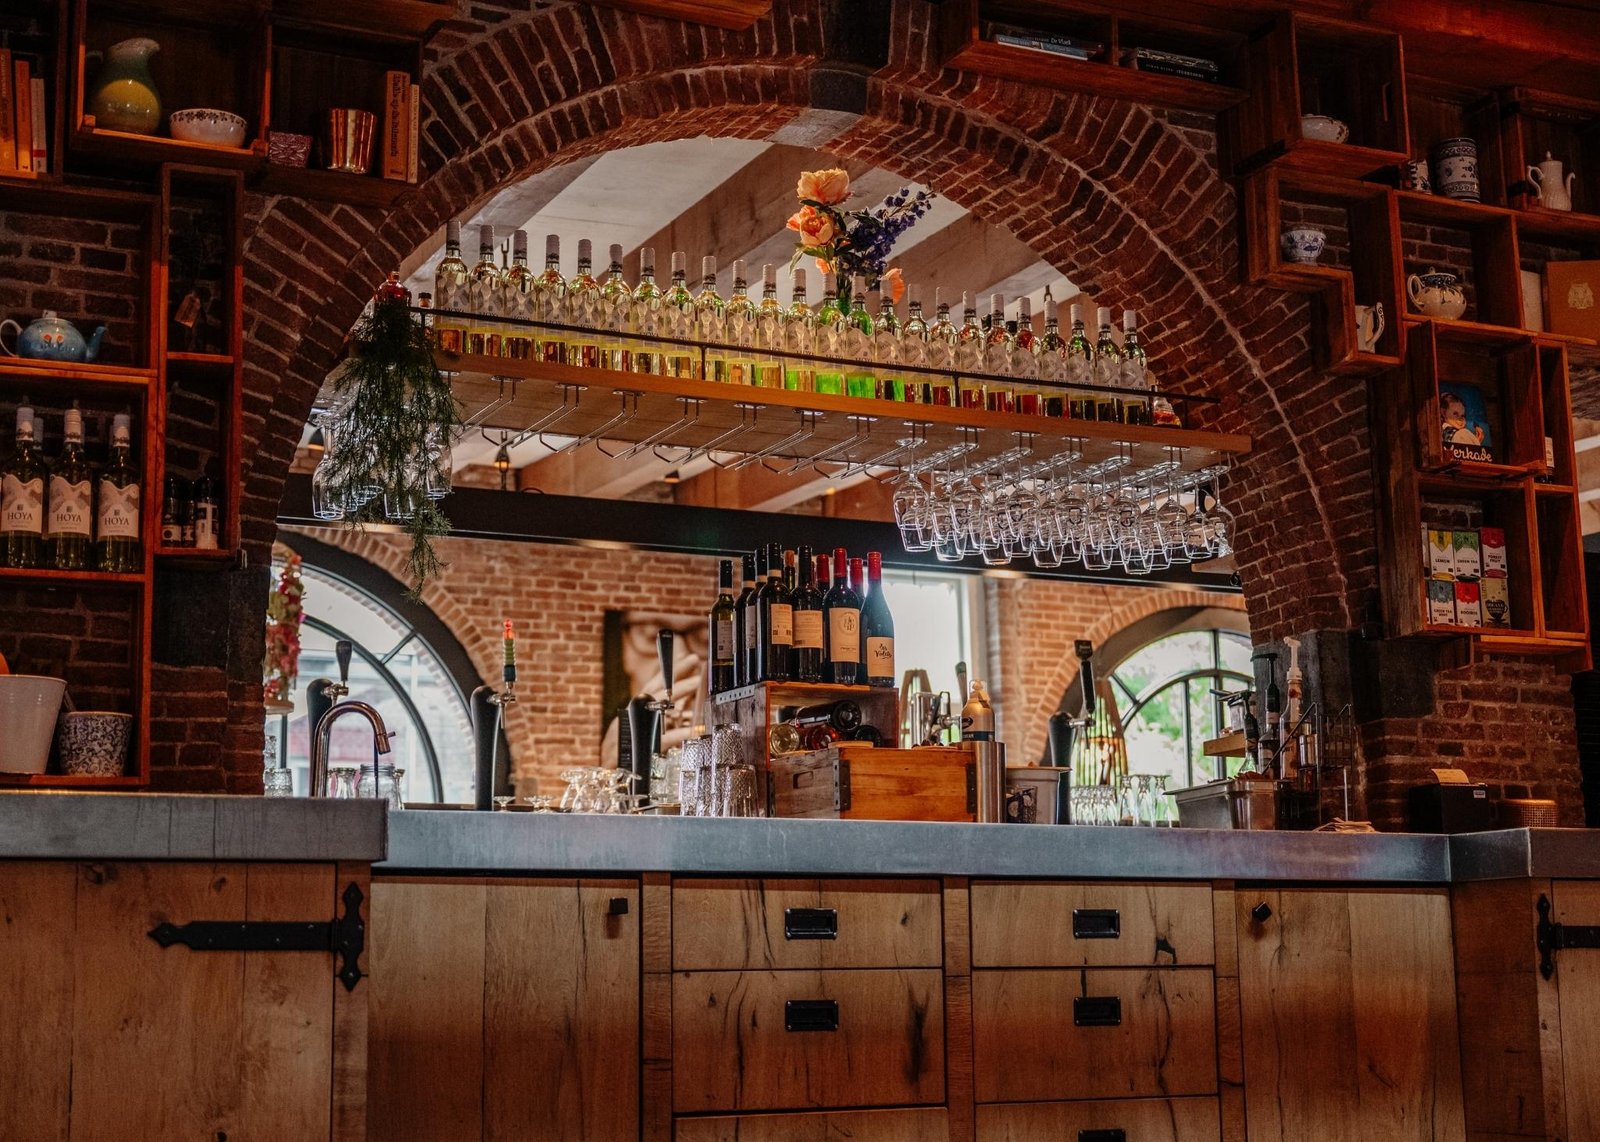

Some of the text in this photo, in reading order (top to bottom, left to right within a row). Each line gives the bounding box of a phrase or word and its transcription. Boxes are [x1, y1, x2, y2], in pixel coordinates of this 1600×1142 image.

[7, 512, 33, 520] HOYA
[56, 513, 82, 521] HOYA
[104, 517, 130, 525] HOYA
